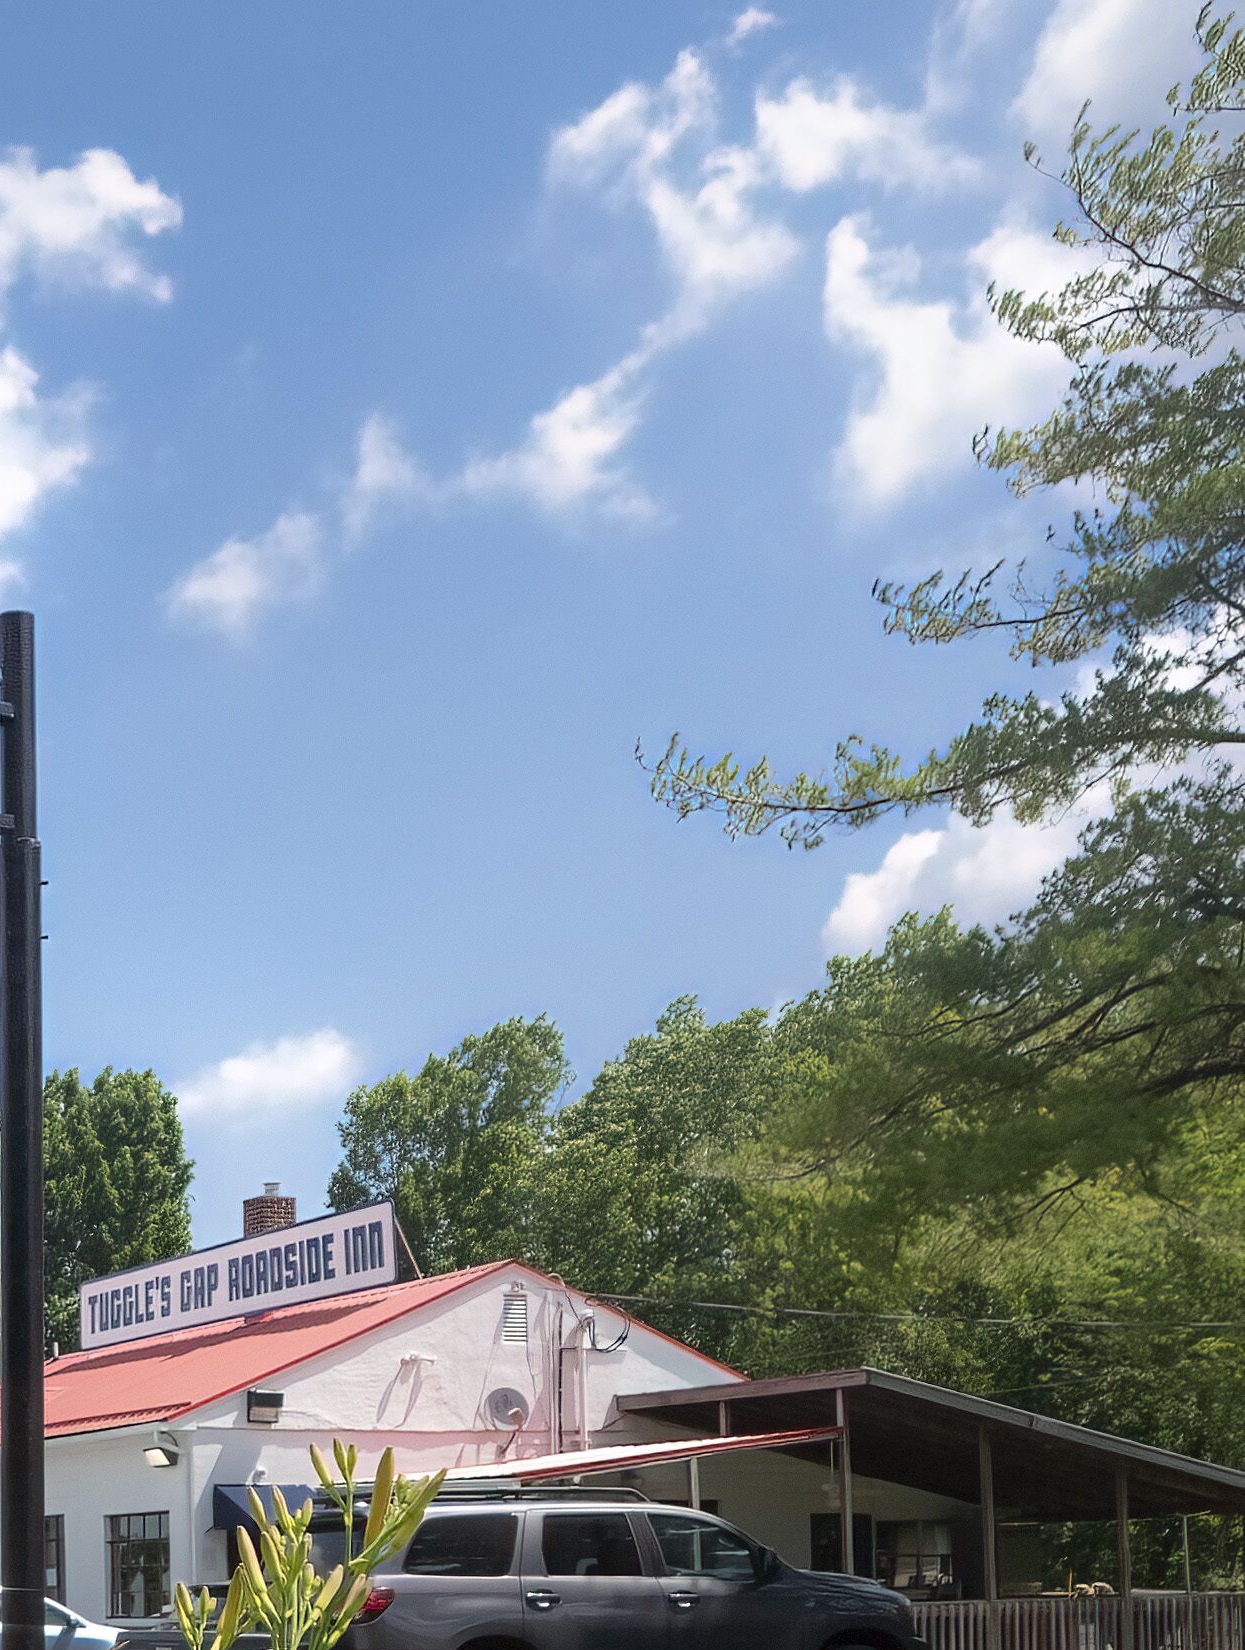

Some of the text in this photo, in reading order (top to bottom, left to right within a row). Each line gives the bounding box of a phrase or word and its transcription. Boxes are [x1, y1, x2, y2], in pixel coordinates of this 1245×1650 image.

[88, 1221, 385, 1335] TUGGLE'S GAP ROADSIDE INN
